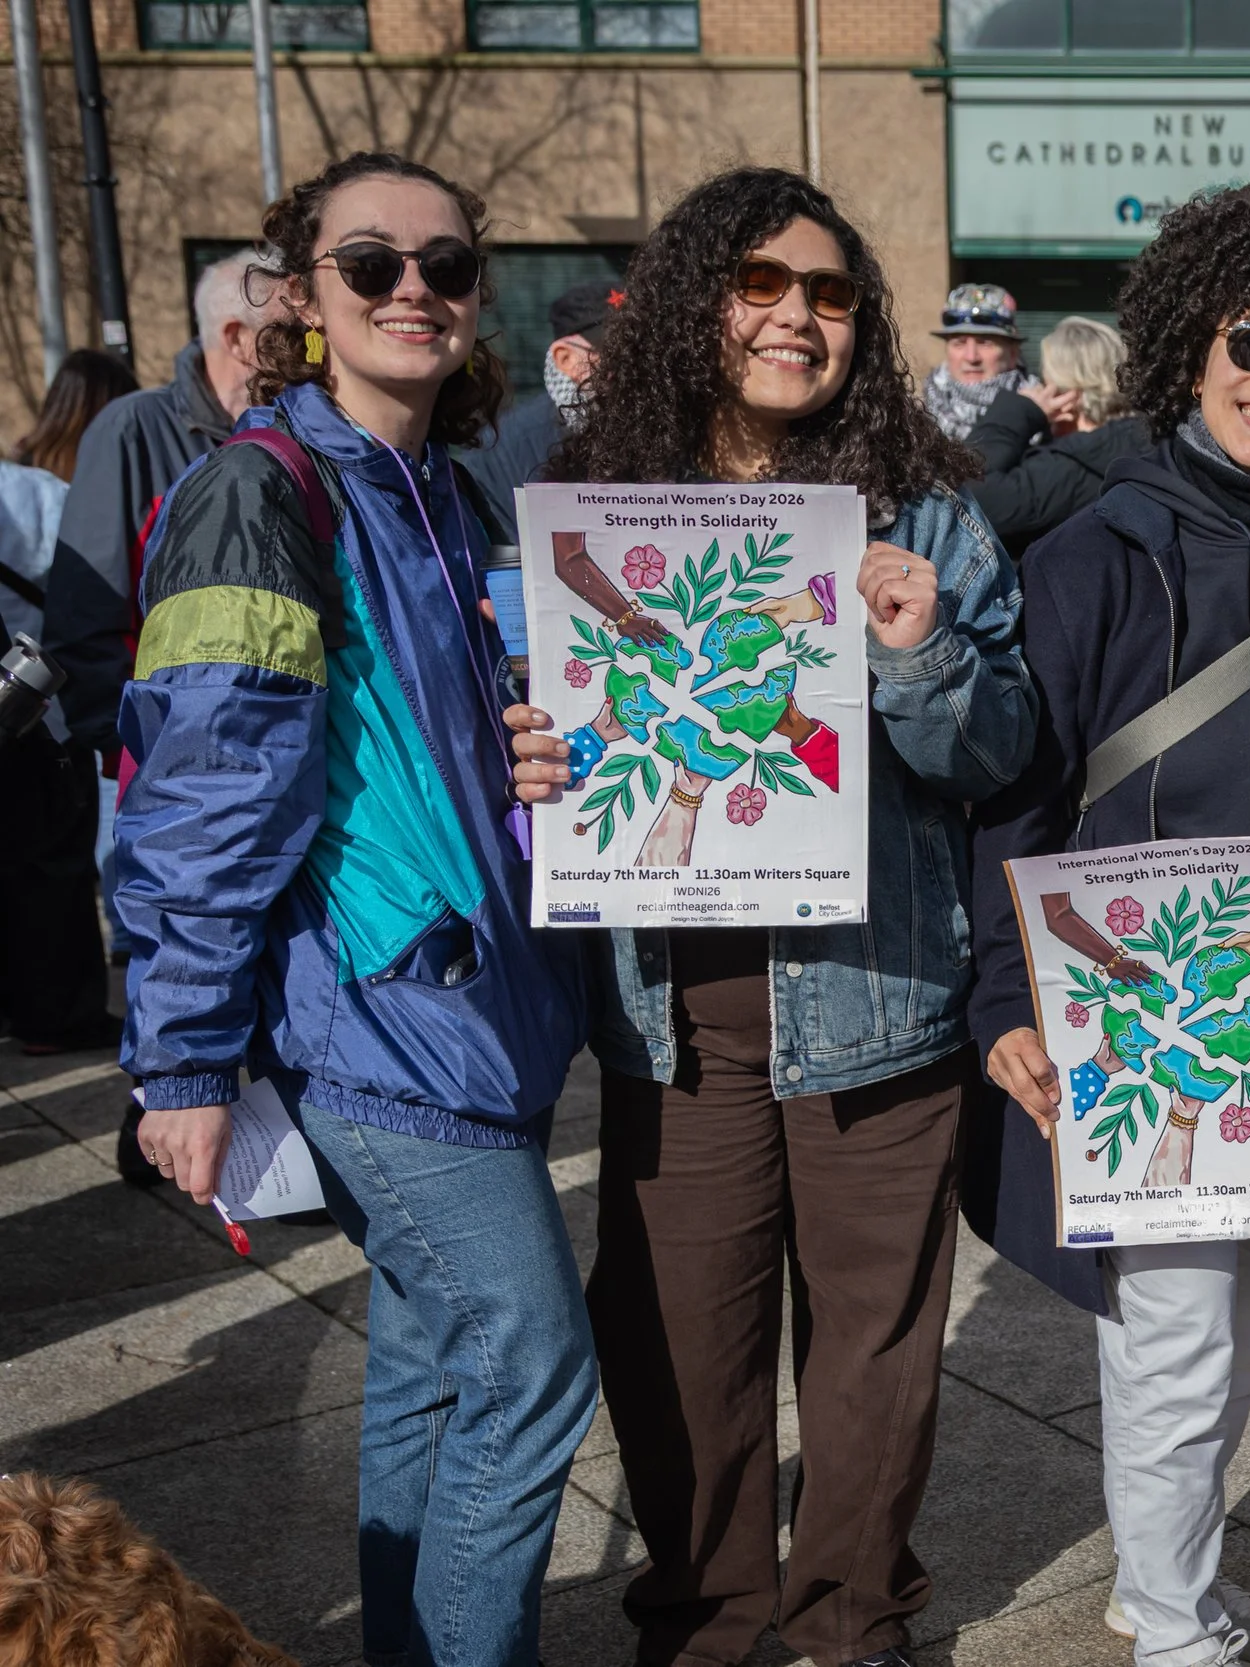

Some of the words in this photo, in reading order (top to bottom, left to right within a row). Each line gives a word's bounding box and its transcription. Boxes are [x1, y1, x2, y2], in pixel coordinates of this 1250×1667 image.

[1155, 115, 1225, 136] NEW
[988, 142, 1193, 165] CATHEDRAL
[578, 493, 667, 504] International
[740, 494, 766, 507] Day
[769, 494, 804, 505] 2026
[605, 514, 677, 529] Strength
[682, 515, 696, 526] in
[701, 515, 777, 530] Solidarity
[1058, 853, 1138, 869] International
[1202, 847, 1225, 856] Day
[551, 869, 610, 883] Saturday
[614, 869, 634, 880] 7th
[639, 869, 679, 880] March
[696, 869, 750, 879] 11.30am
[754, 869, 801, 879] Writers
[805, 869, 850, 881] Square
[1085, 869, 1149, 884] Strength
[1152, 867, 1166, 878] in
[1170, 862, 1238, 876] Solidarity
[674, 887, 720, 896] IWDNI26
[637, 902, 759, 913] reclaimtheagenda.com
[818, 910, 830, 918] City
[831, 909, 853, 917] Council
[819, 904, 841, 912] Belfast
[1069, 1192, 1121, 1204] Saturday
[1124, 1190, 1142, 1200] 7th
[1146, 1188, 1182, 1199] March
[1197, 1185, 1246, 1196] 11.30am
